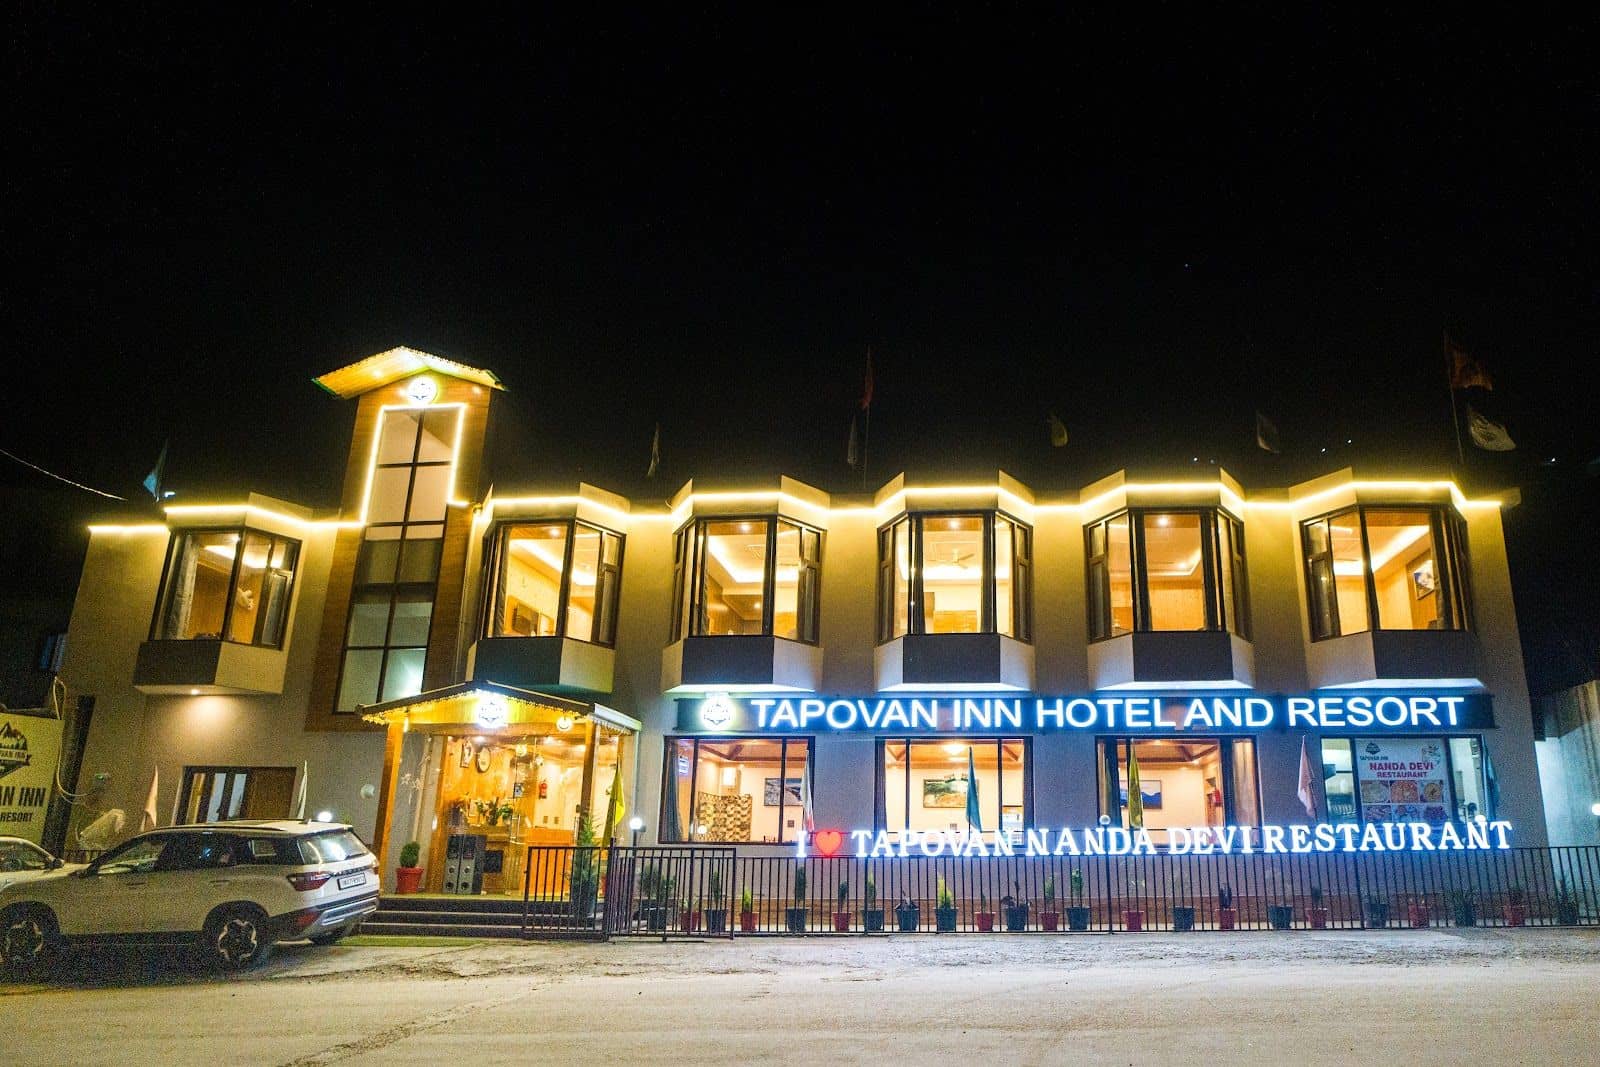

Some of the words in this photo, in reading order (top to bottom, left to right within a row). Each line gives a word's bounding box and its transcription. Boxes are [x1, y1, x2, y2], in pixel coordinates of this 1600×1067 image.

[751, 700, 937, 728] TAPOVAN
[953, 699, 1022, 728] INN
[1036, 698, 1176, 728] HOTEL
[1183, 698, 1274, 727] AND
[1287, 696, 1465, 727] RESORT
[1369, 762, 1406, 770] NANDA
[1409, 762, 1434, 770] DEVI
[18, 787, 47, 807] INN
[796, 830, 807, 857] I
[851, 829, 1015, 857] TAPOVAN
[1025, 827, 1157, 856] NANDA
[1167, 826, 1254, 854] DEVI
[1263, 821, 1513, 853] RESTAURANT
